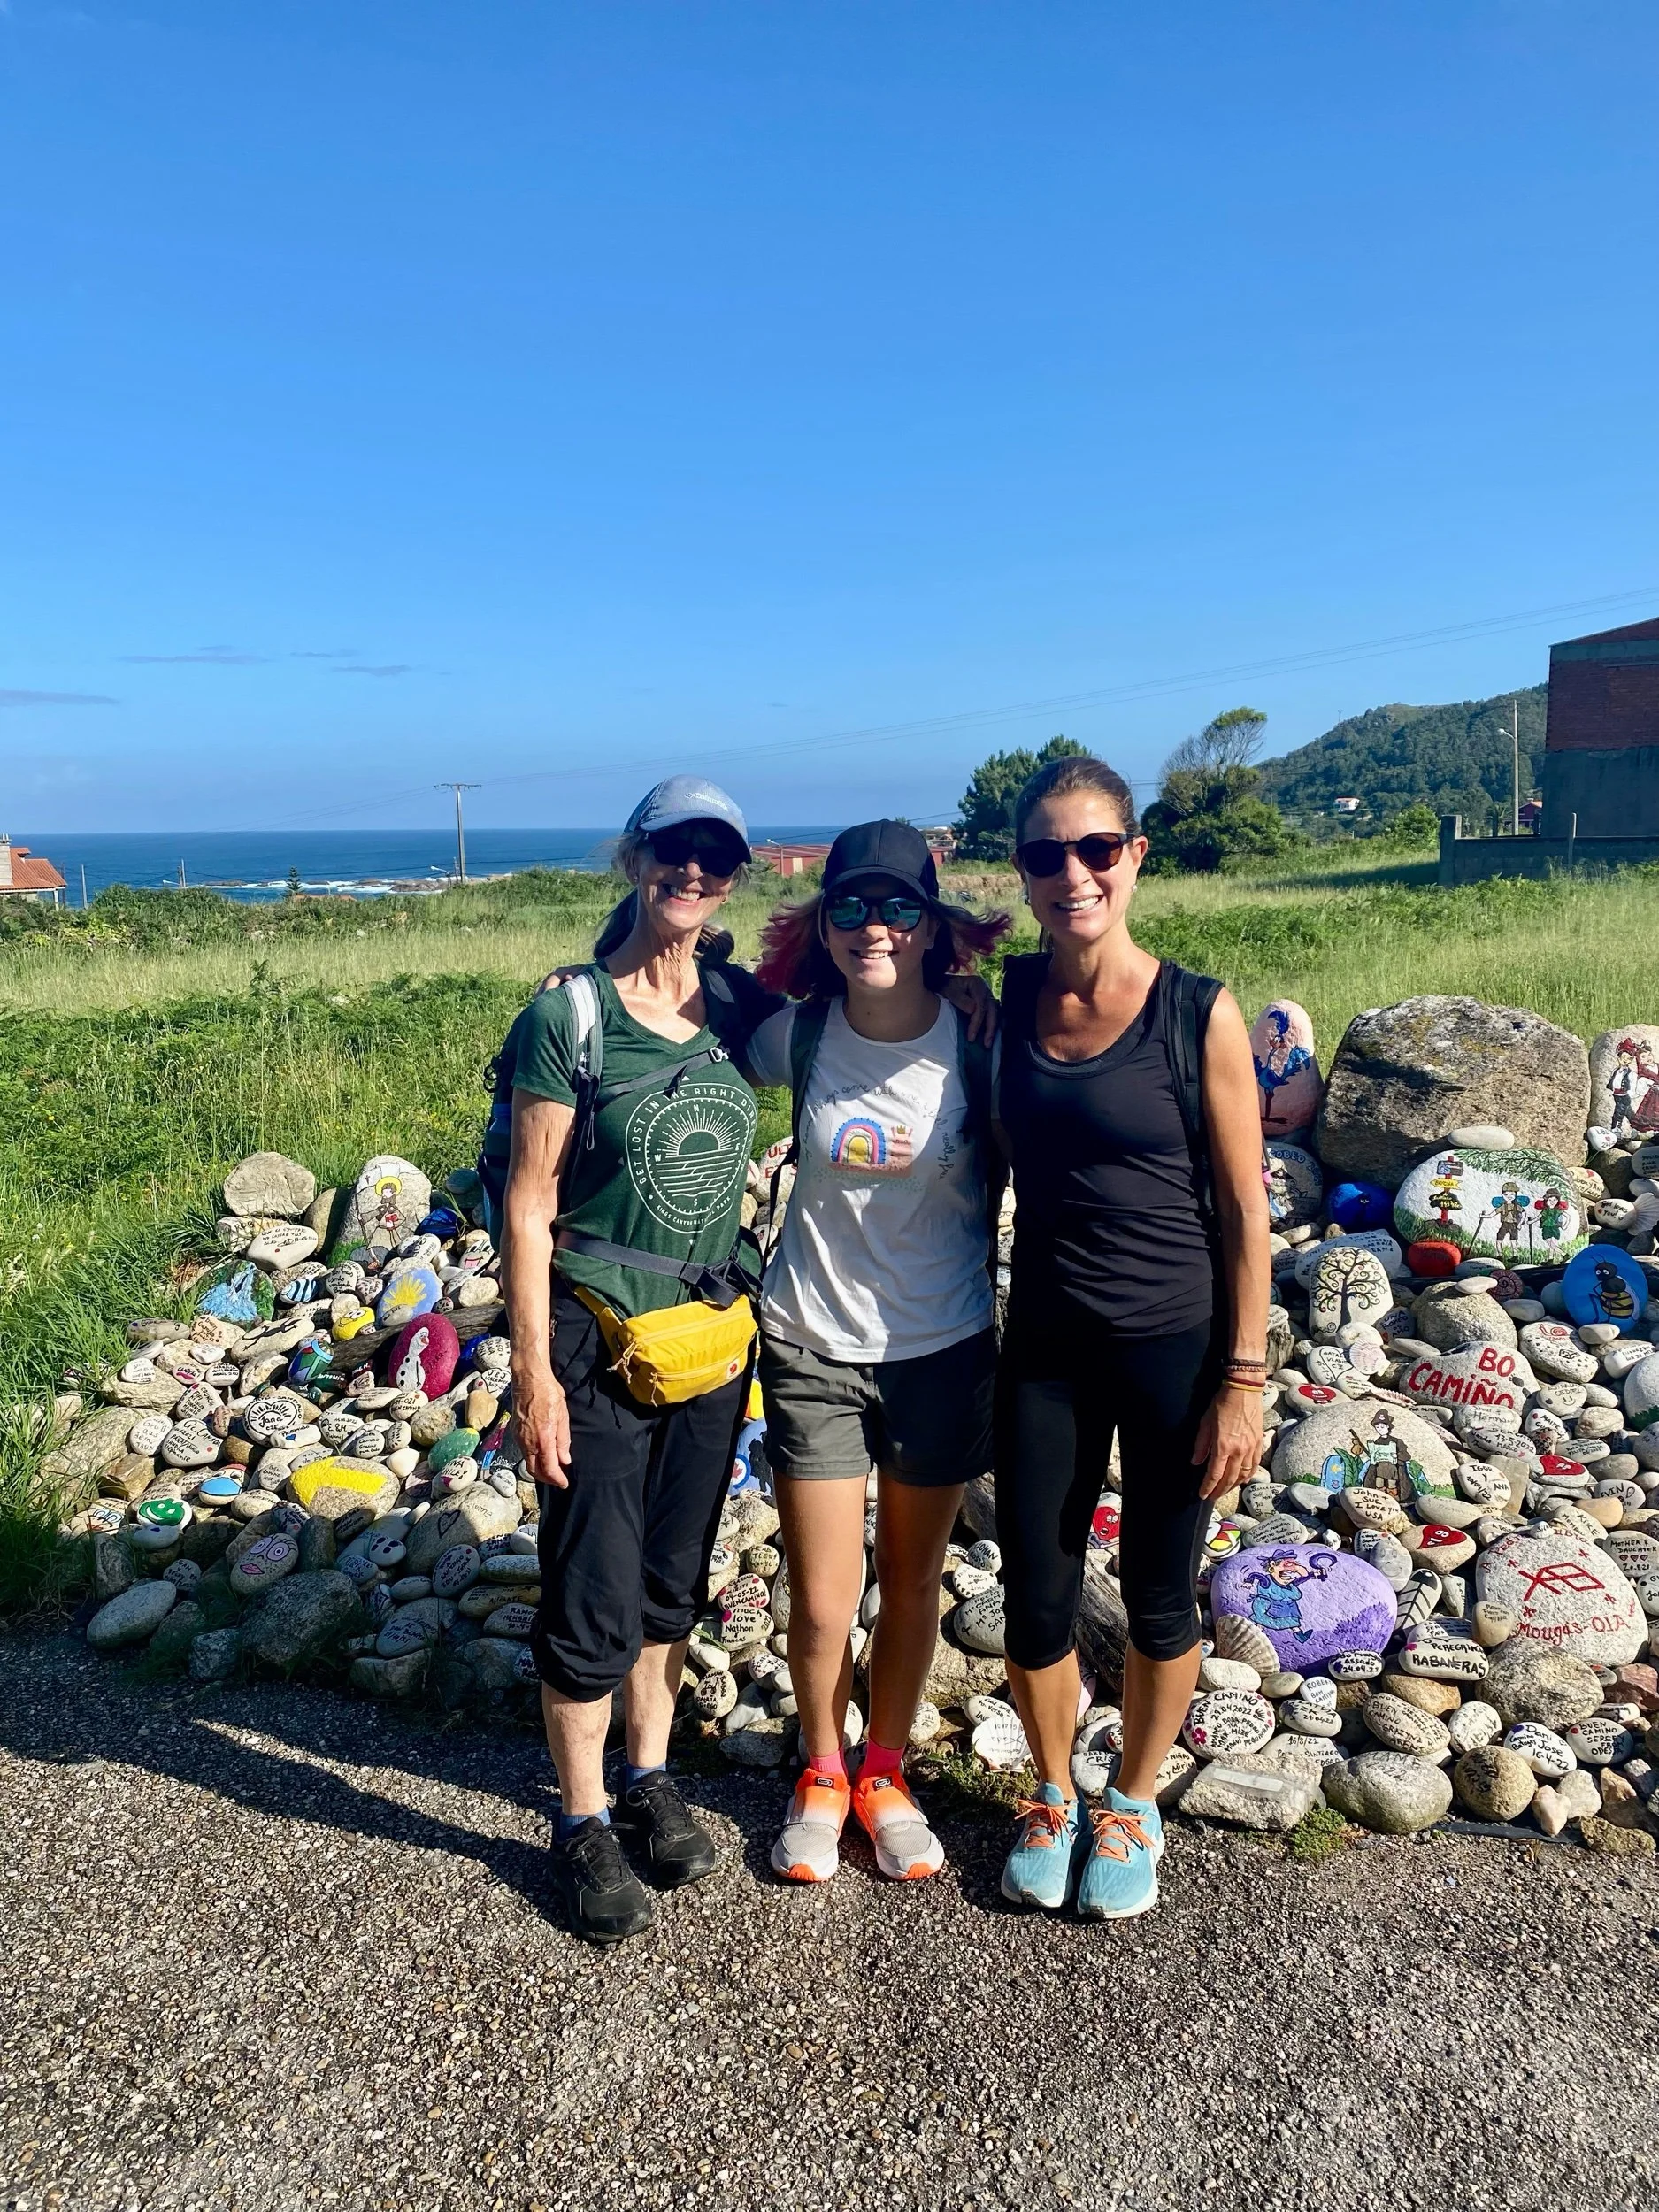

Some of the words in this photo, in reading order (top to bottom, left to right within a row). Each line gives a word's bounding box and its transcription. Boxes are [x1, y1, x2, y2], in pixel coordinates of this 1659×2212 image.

[695, 1087, 735, 1099] RIGHT
[645, 1100, 660, 1113] IN
[632, 1118, 646, 1151] LOST
[634, 1160, 647, 1185] GET
[656, 1204, 672, 1219] KINGS
[716, 1195, 732, 1210] PARK
[1478, 1348, 1516, 1378] BO
[1408, 1363, 1515, 1409] CAMIÑO
[1353, 1488, 1379, 1498] John
[1365, 1510, 1383, 1521] USA
[975, 1542, 998, 1560] JOHAN
[1412, 1654, 1486, 1678] RABANERAS
[1194, 1700, 1211, 1726] BUEN
[1214, 1692, 1259, 1706] CAMINO
[1372, 1701, 1398, 1714] BUEN
[1369, 1710, 1402, 1724] CAMINO
[1525, 1724, 1552, 1741] Dani
[1086, 1755, 1116, 1765] CRIS
[1532, 1748, 1569, 1770] 16-4-22
